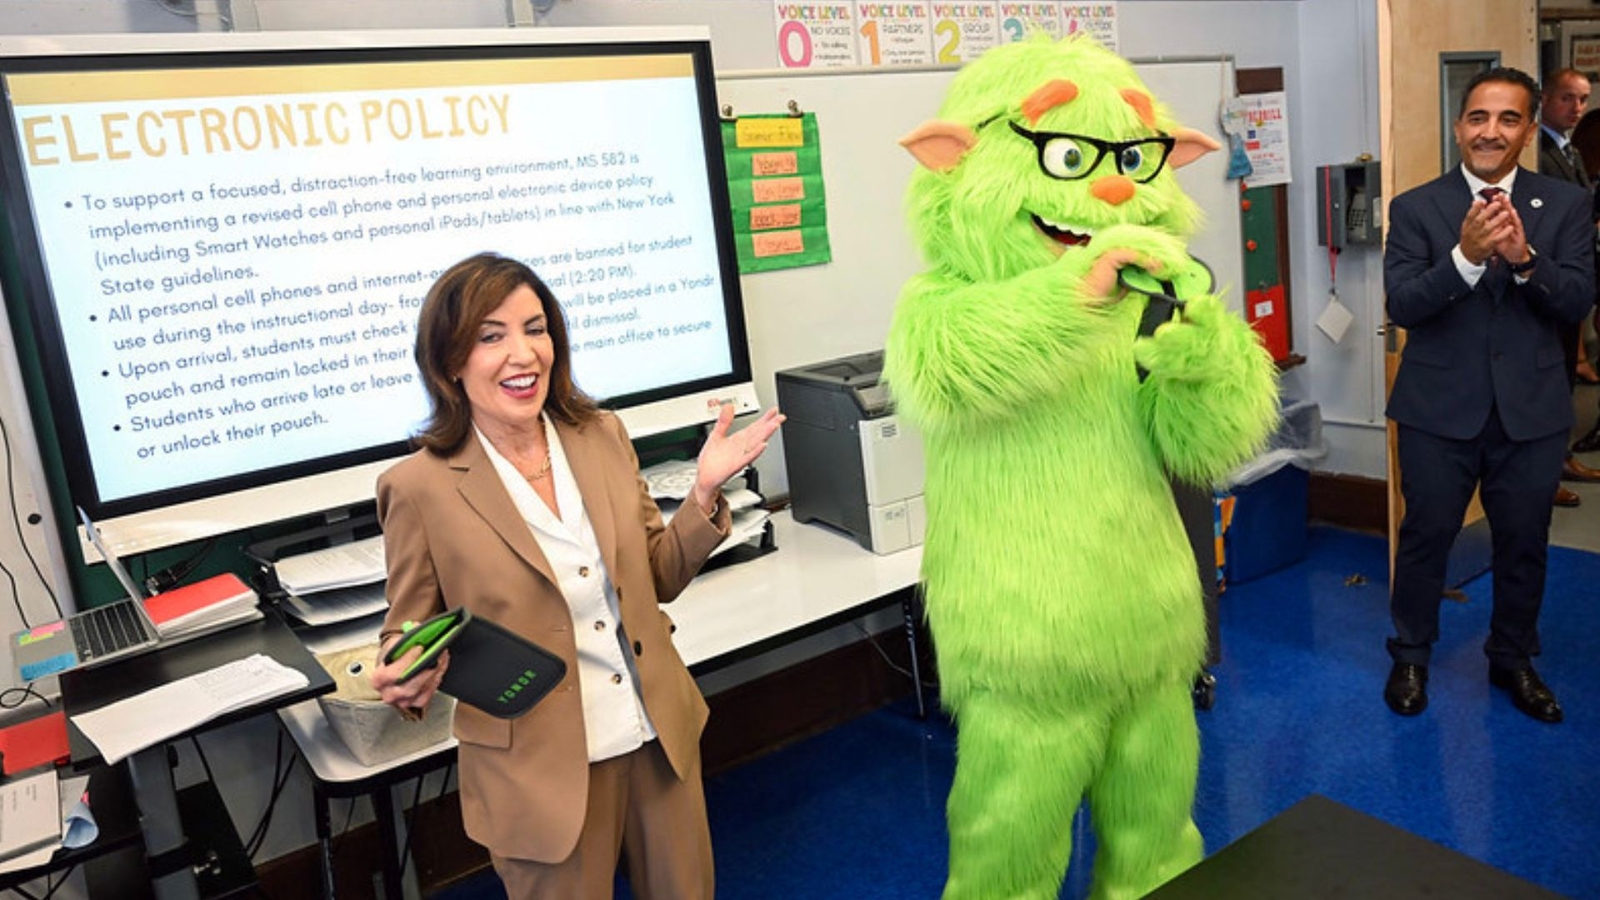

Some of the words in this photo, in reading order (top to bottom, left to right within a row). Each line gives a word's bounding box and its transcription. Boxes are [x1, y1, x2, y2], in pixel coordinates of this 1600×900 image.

[778, 5, 815, 19] VOICE
[818, 6, 850, 20] LEVEL
[811, 27, 823, 35] NO
[860, 4, 894, 17] VOICE
[897, 4, 926, 17] LEVEL
[934, 5, 965, 17] VOICE
[968, 5, 994, 17] LEVEL
[1002, 3, 1031, 16] VOICE
[1033, 4, 1056, 16] LEVEL
[1064, 6, 1090, 17] VOICE
[1093, 6, 1115, 17] LEVEL
[778, 20, 813, 68] 0
[860, 20, 881, 65] 1
[934, 19, 961, 64] 2
[22, 102, 350, 166] ELECTRONIC
[361, 94, 510, 143] POLICY
[83, 194, 107, 210] To
[112, 189, 185, 212] support
[191, 190, 204, 202] a
[209, 178, 286, 200] focused,
[290, 169, 417, 193] distraction-free
[421, 167, 481, 182] learning
[485, 158, 574, 176] environment,
[577, 154, 598, 167] MS
[601, 151, 626, 166] 582
[630, 154, 639, 164] is
[88, 216, 220, 242] implementing
[224, 214, 237, 227] a
[242, 203, 304, 224] revised
[308, 200, 338, 219] cell
[342, 198, 392, 218] phone
[396, 192, 427, 210] and
[431, 187, 494, 210] personal
[498, 183, 566, 199] electronic
[569, 179, 613, 192] device
[616, 173, 653, 191] policy
[94, 244, 191, 271] (including
[194, 238, 249, 257] Smart
[252, 229, 329, 249] Watches
[332, 224, 364, 242] and
[368, 216, 435, 242] personal
[439, 207, 541, 229] iPads/tablets)
[544, 208, 556, 218] in
[559, 203, 584, 215] line
[586, 199, 615, 213] with
[617, 198, 645, 210] New
[648, 192, 674, 206] York
[100, 277, 155, 296] State
[161, 265, 259, 294] guidelines.
[108, 304, 132, 324] All
[138, 293, 219, 324] personal
[223, 288, 256, 308] cell
[260, 285, 323, 308] phones
[326, 275, 358, 294] and
[549, 252, 572, 264] are
[575, 242, 625, 261] banned
[627, 241, 646, 253] for
[648, 235, 693, 252] student
[113, 336, 147, 351] use
[152, 326, 212, 345] during
[216, 319, 246, 336] the
[250, 302, 354, 331] instructional
[358, 300, 394, 316] day-
[569, 267, 605, 287] (2:20
[118, 360, 171, 381] Upon
[175, 345, 238, 369] arrival,
[242, 337, 315, 359] students
[319, 329, 357, 347] must
[362, 320, 408, 341] check
[587, 292, 605, 306] be
[607, 283, 652, 305] placed
[654, 284, 666, 293] in
[668, 282, 677, 293] a
[680, 274, 715, 289] Yondr
[124, 381, 185, 409] pouch
[189, 373, 226, 394] and
[230, 367, 291, 388] remain
[293, 353, 350, 377] locked
[354, 354, 369, 367] in
[372, 348, 408, 363] their
[130, 406, 215, 432] Students
[218, 398, 256, 416] who
[260, 390, 309, 409] arrive
[312, 384, 346, 399] late
[350, 381, 367, 393] or
[370, 373, 413, 389] leave
[583, 337, 615, 350] main
[617, 329, 655, 345] office
[656, 327, 670, 337] to
[672, 320, 712, 336] secure
[136, 445, 156, 459] or
[161, 429, 222, 454] unlock
[225, 423, 266, 442] their
[270, 410, 328, 438] pouch.
[497, 669, 537, 704] YONDR
